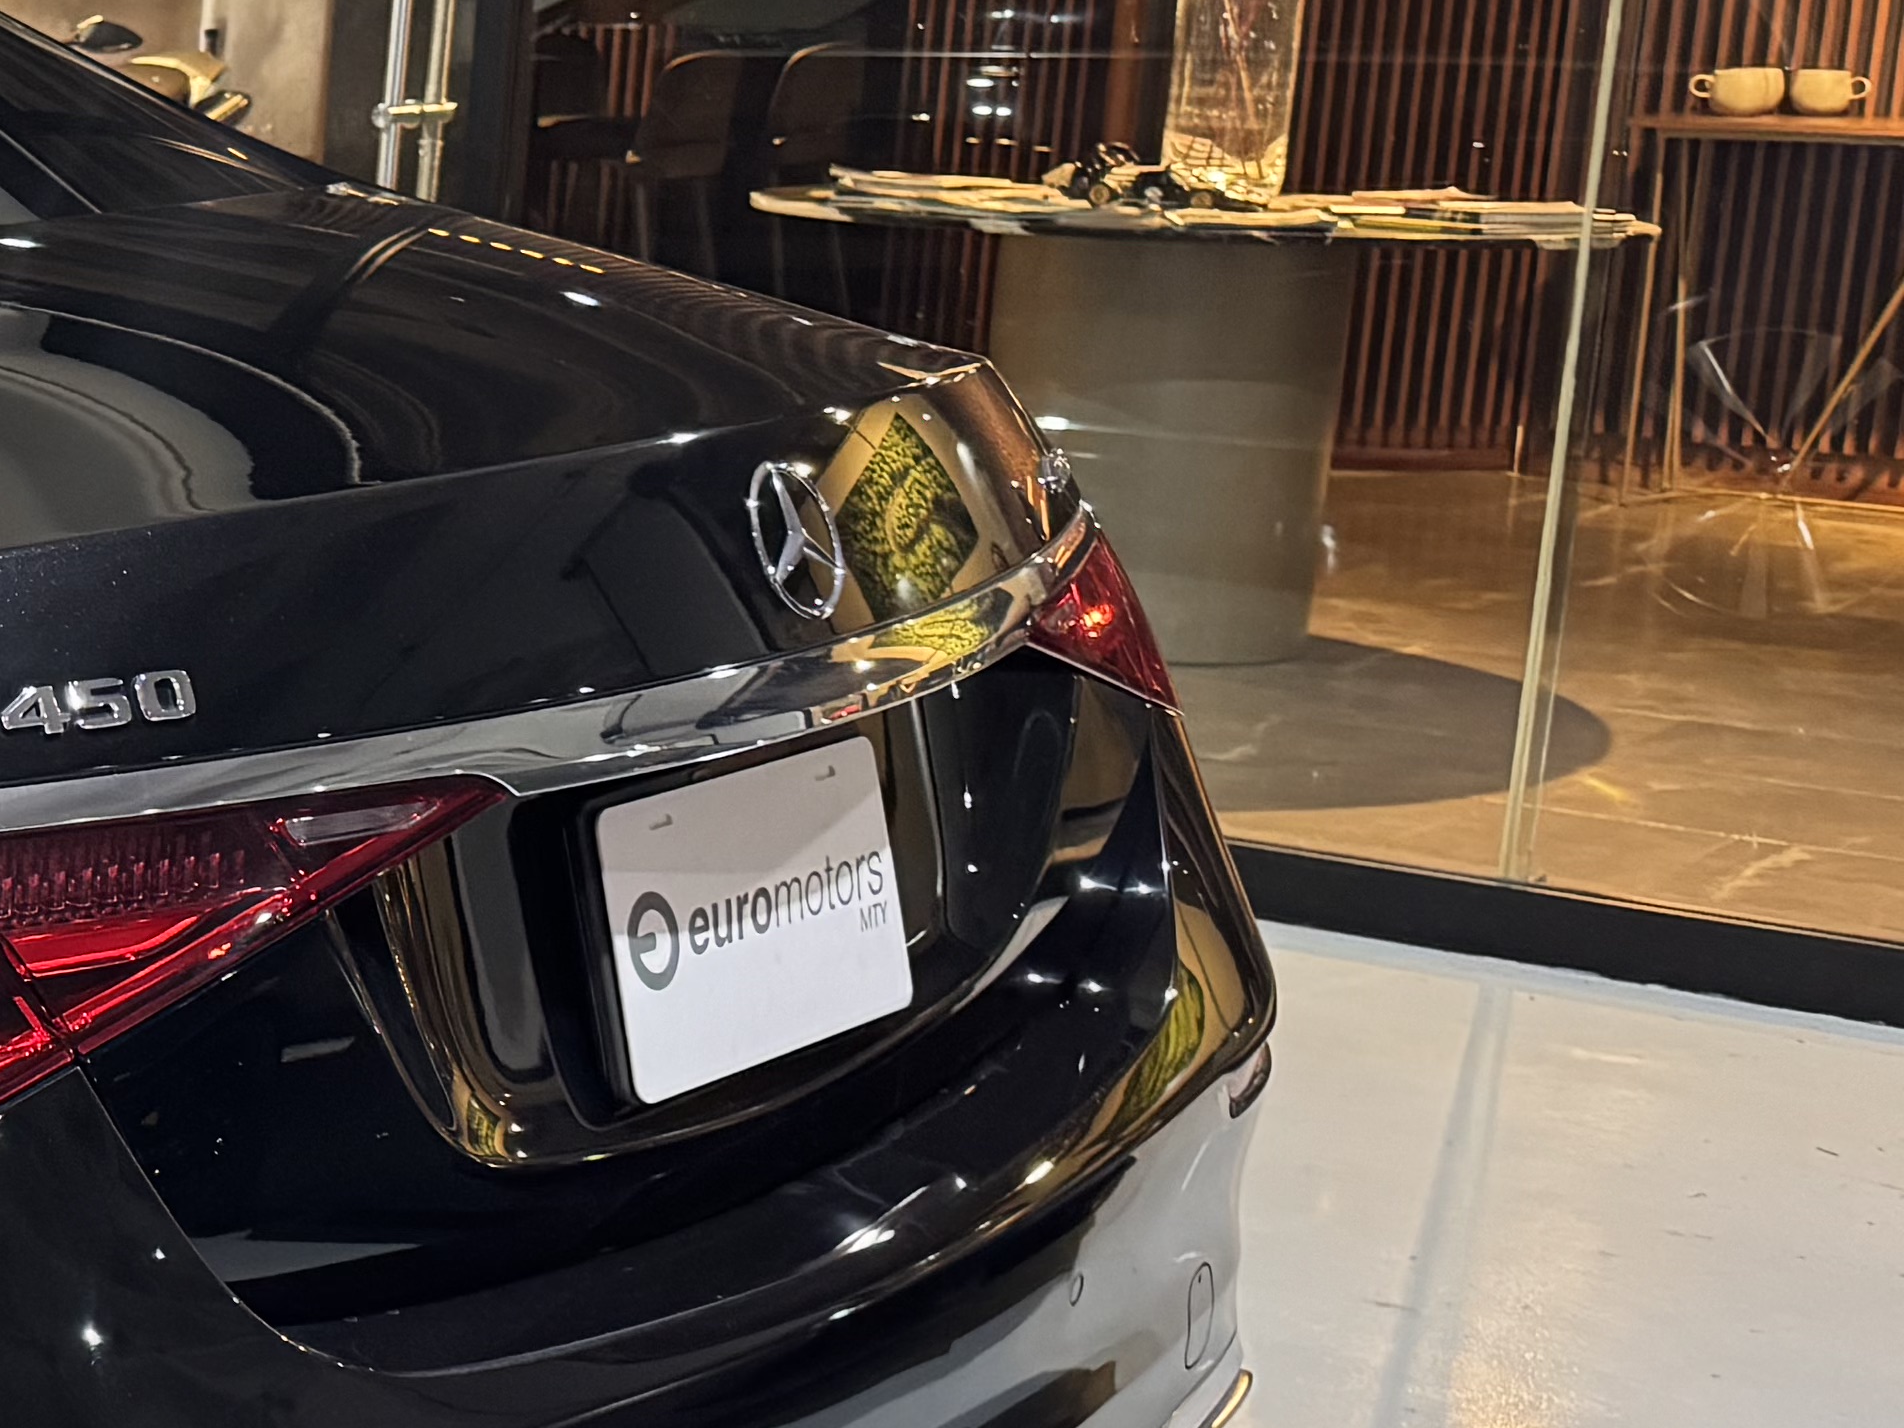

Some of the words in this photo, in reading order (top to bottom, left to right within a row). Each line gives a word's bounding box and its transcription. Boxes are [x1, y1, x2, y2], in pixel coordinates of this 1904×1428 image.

[0, 669, 197, 735] 450
[688, 850, 885, 955] euromotors
[859, 901, 889, 933] MTY
